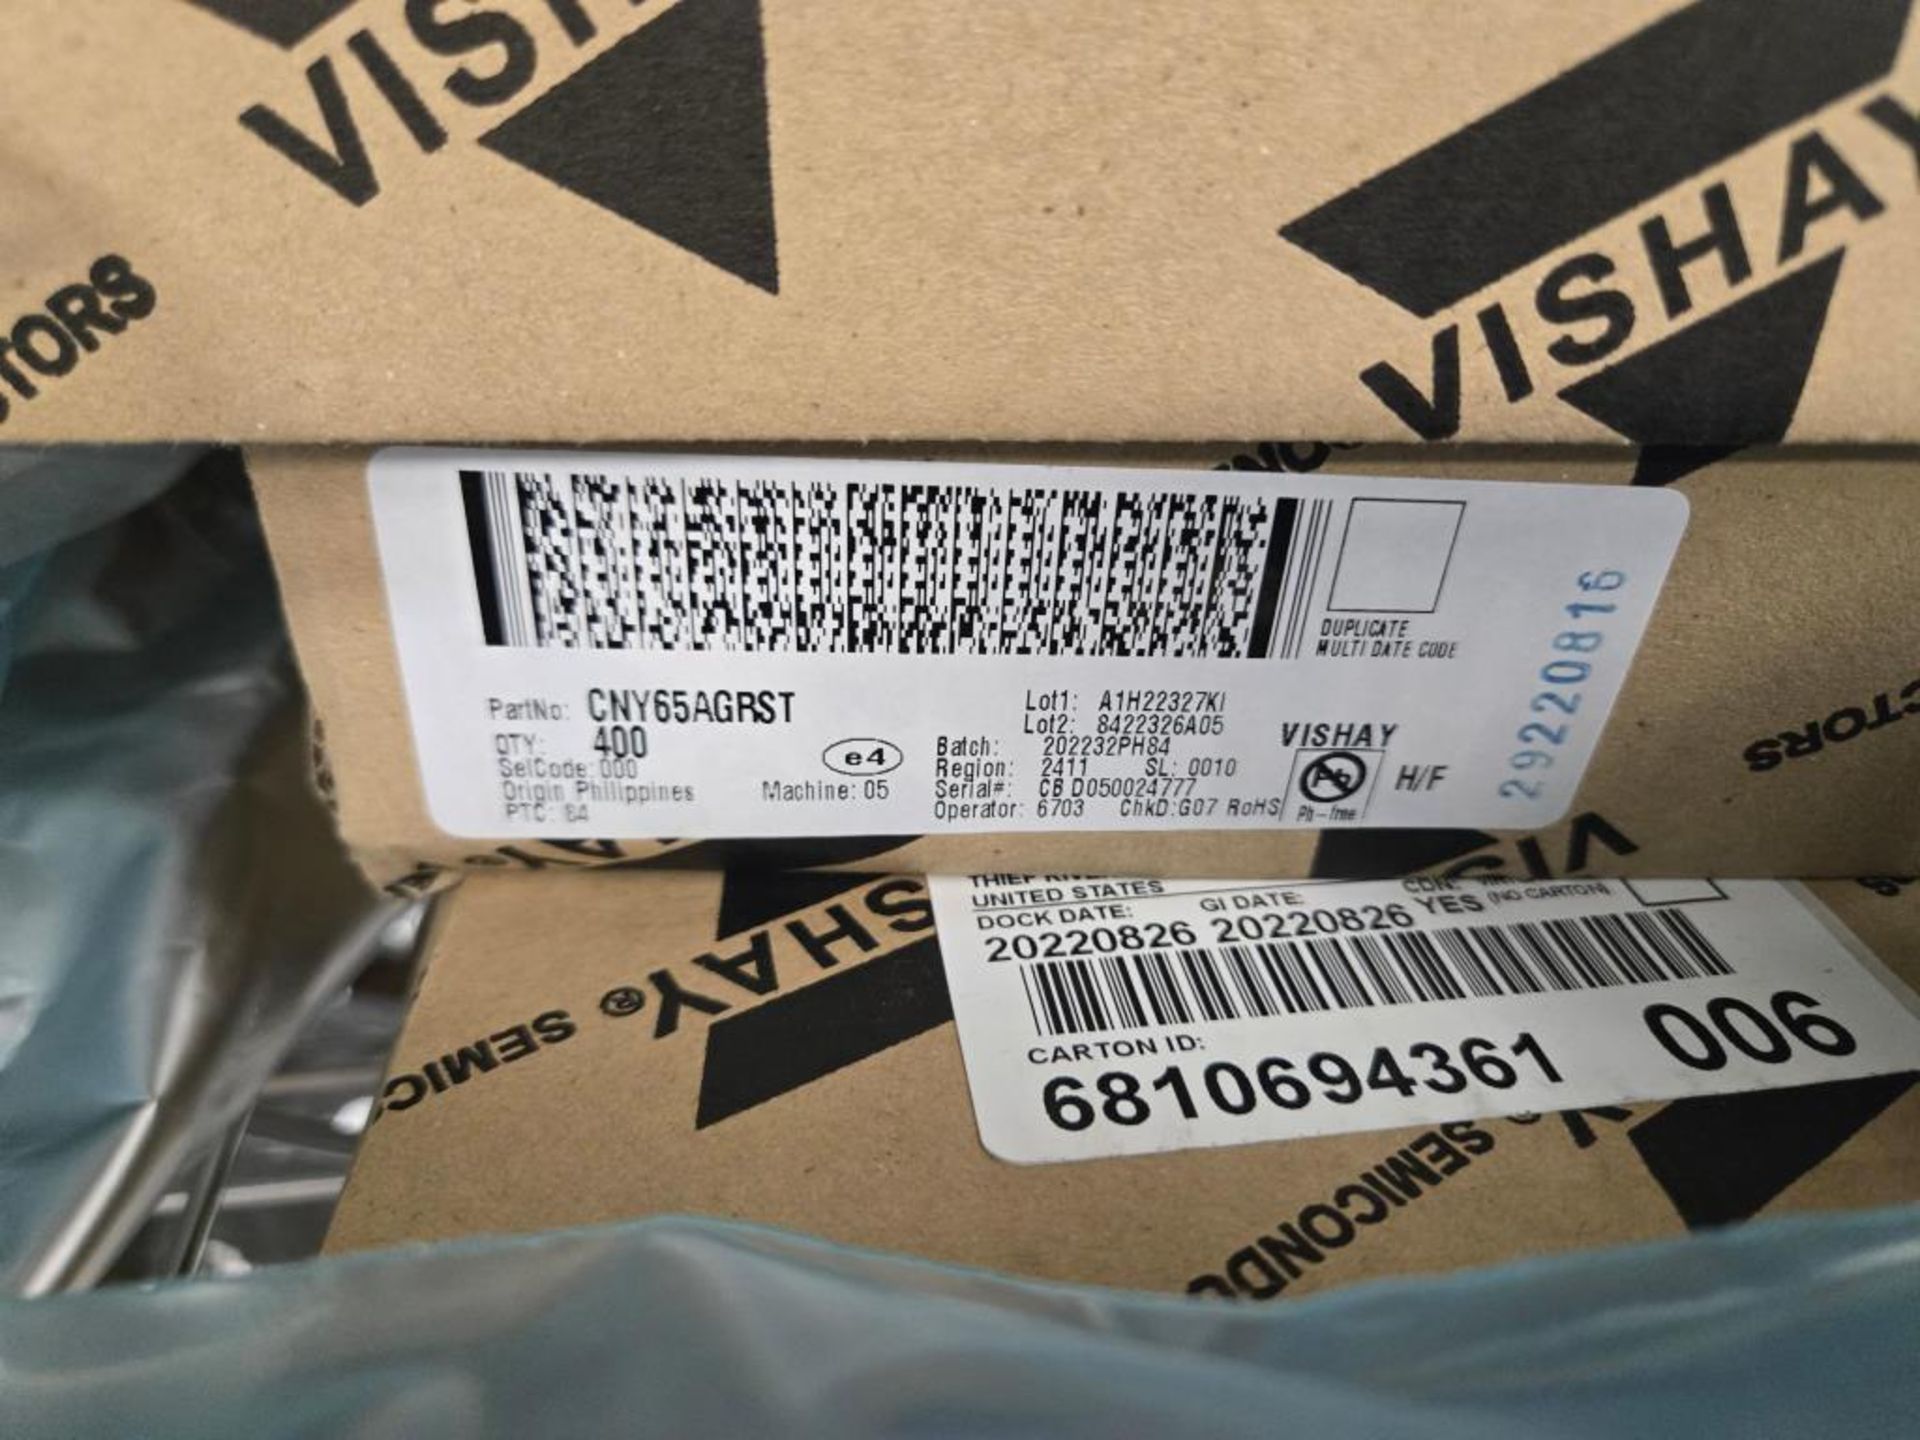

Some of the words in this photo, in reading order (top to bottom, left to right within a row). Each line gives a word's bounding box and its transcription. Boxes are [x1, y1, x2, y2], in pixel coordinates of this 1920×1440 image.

[237, 0, 650, 207] VIS
[0, 254, 156, 424] TORS
[1320, 618, 1411, 638] DUPLICATE
[1315, 639, 1367, 657] MULTI
[1371, 639, 1412, 658] DATE
[1417, 640, 1460, 659] CODE
[488, 697, 570, 721] PartNo:
[588, 687, 796, 724] CNY65AGRST
[1026, 689, 1077, 711] Lot1:
[1023, 713, 1075, 735] Lot2:
[1096, 714, 1225, 736] 8422326A05
[1281, 723, 1398, 748] VISHAY
[593, 725, 648, 759] 400
[937, 736, 998, 757] Batch:
[1043, 736, 1171, 757] 202232PH84
[600, 758, 638, 779] 000
[845, 748, 886, 766] e4
[935, 757, 1012, 780] Region:
[1041, 757, 1088, 777] 2411
[1145, 757, 1177, 777] SL:
[1187, 758, 1237, 777] 0010
[762, 780, 856, 801] Machine:
[864, 779, 890, 800] 05
[934, 778, 1011, 800] Serial#:
[1395, 765, 1448, 792] H/F
[575, 780, 695, 804] Philippines
[934, 799, 1023, 822] Operator:
[1037, 799, 1085, 818] 6703
[1227, 798, 1281, 817] RoHS
[972, 888, 1064, 908] UNITED
[1071, 880, 1166, 900] STATES
[1200, 896, 1231, 913] GI
[1234, 889, 1306, 909] DATE:
[1413, 893, 1485, 915] YES
[1487, 890, 1523, 904] (NO
[977, 910, 1053, 931] DOCK
[1059, 904, 1133, 924] DATE:
[1211, 904, 1414, 943] 20220826
[984, 921, 1197, 963] 20220826
[1643, 990, 1856, 1071] 006
[1027, 1038, 1157, 1065] CARTON
[1166, 1034, 1205, 1053] ID:
[373, 1009, 577, 1124] SEMIC
[1043, 1033, 1563, 1131] 6810694361
